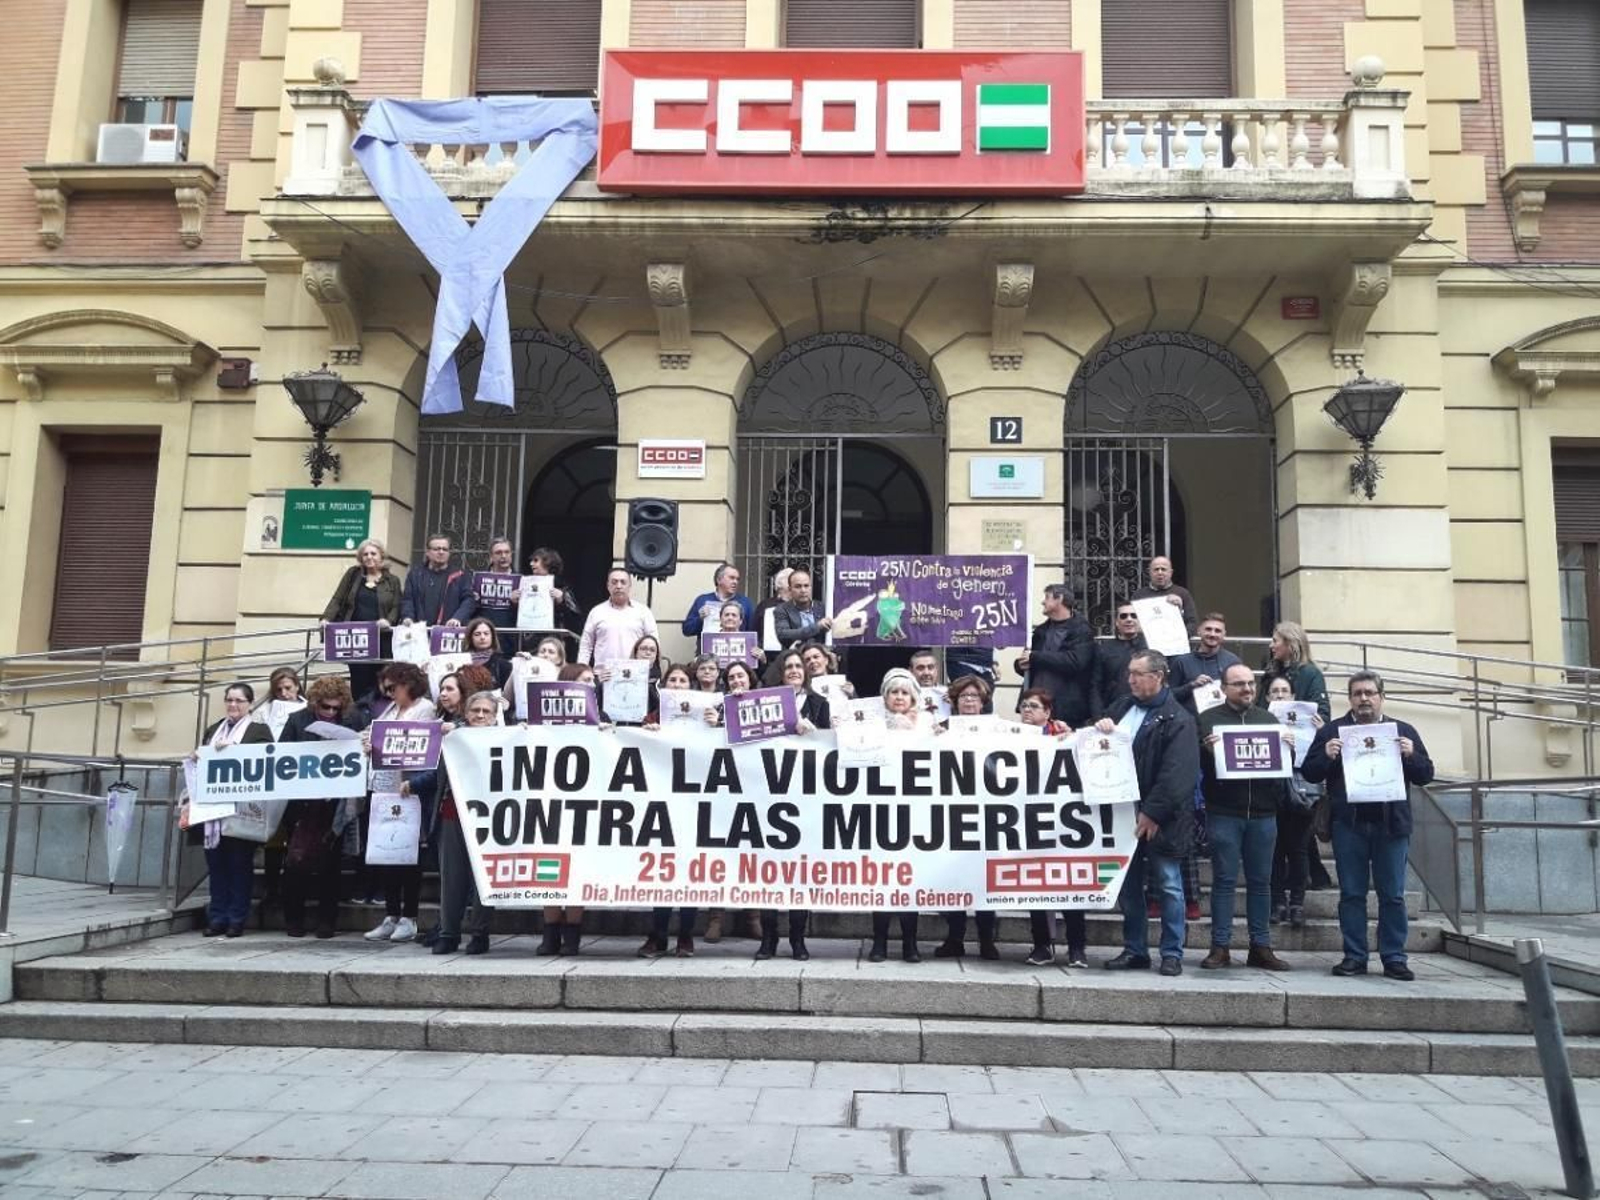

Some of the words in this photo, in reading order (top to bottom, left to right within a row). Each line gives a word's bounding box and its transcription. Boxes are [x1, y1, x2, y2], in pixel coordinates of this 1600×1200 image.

[631, 79, 962, 155] CCOO
[995, 420, 1018, 439] 12
[644, 450, 688, 461] CCOO
[839, 571, 877, 580] CCOO
[881, 560, 911, 578] 25N
[912, 560, 952, 579] Contra
[962, 563, 1014, 578] violencia
[936, 580, 949, 590] de
[911, 602, 927, 616] No
[971, 599, 1018, 630] 25N
[608, 747, 648, 792] A
[672, 748, 743, 794] LA
[760, 748, 1083, 796] VIOLENCIA
[467, 799, 676, 847] CONTRA
[696, 801, 801, 850] LAS
[823, 801, 1115, 851] MUJERES!
[638, 852, 676, 882] 25
[689, 852, 726, 884] de
[739, 853, 913, 886] Noviembre
[995, 862, 1094, 886] CCOO
[614, 885, 724, 904] Internacional
[730, 886, 785, 905] Contra
[790, 888, 804, 905] la
[809, 888, 884, 907] Violencia
[890, 889, 910, 907] de
[1018, 894, 1069, 904] provincial
[1072, 894, 1085, 904] de
